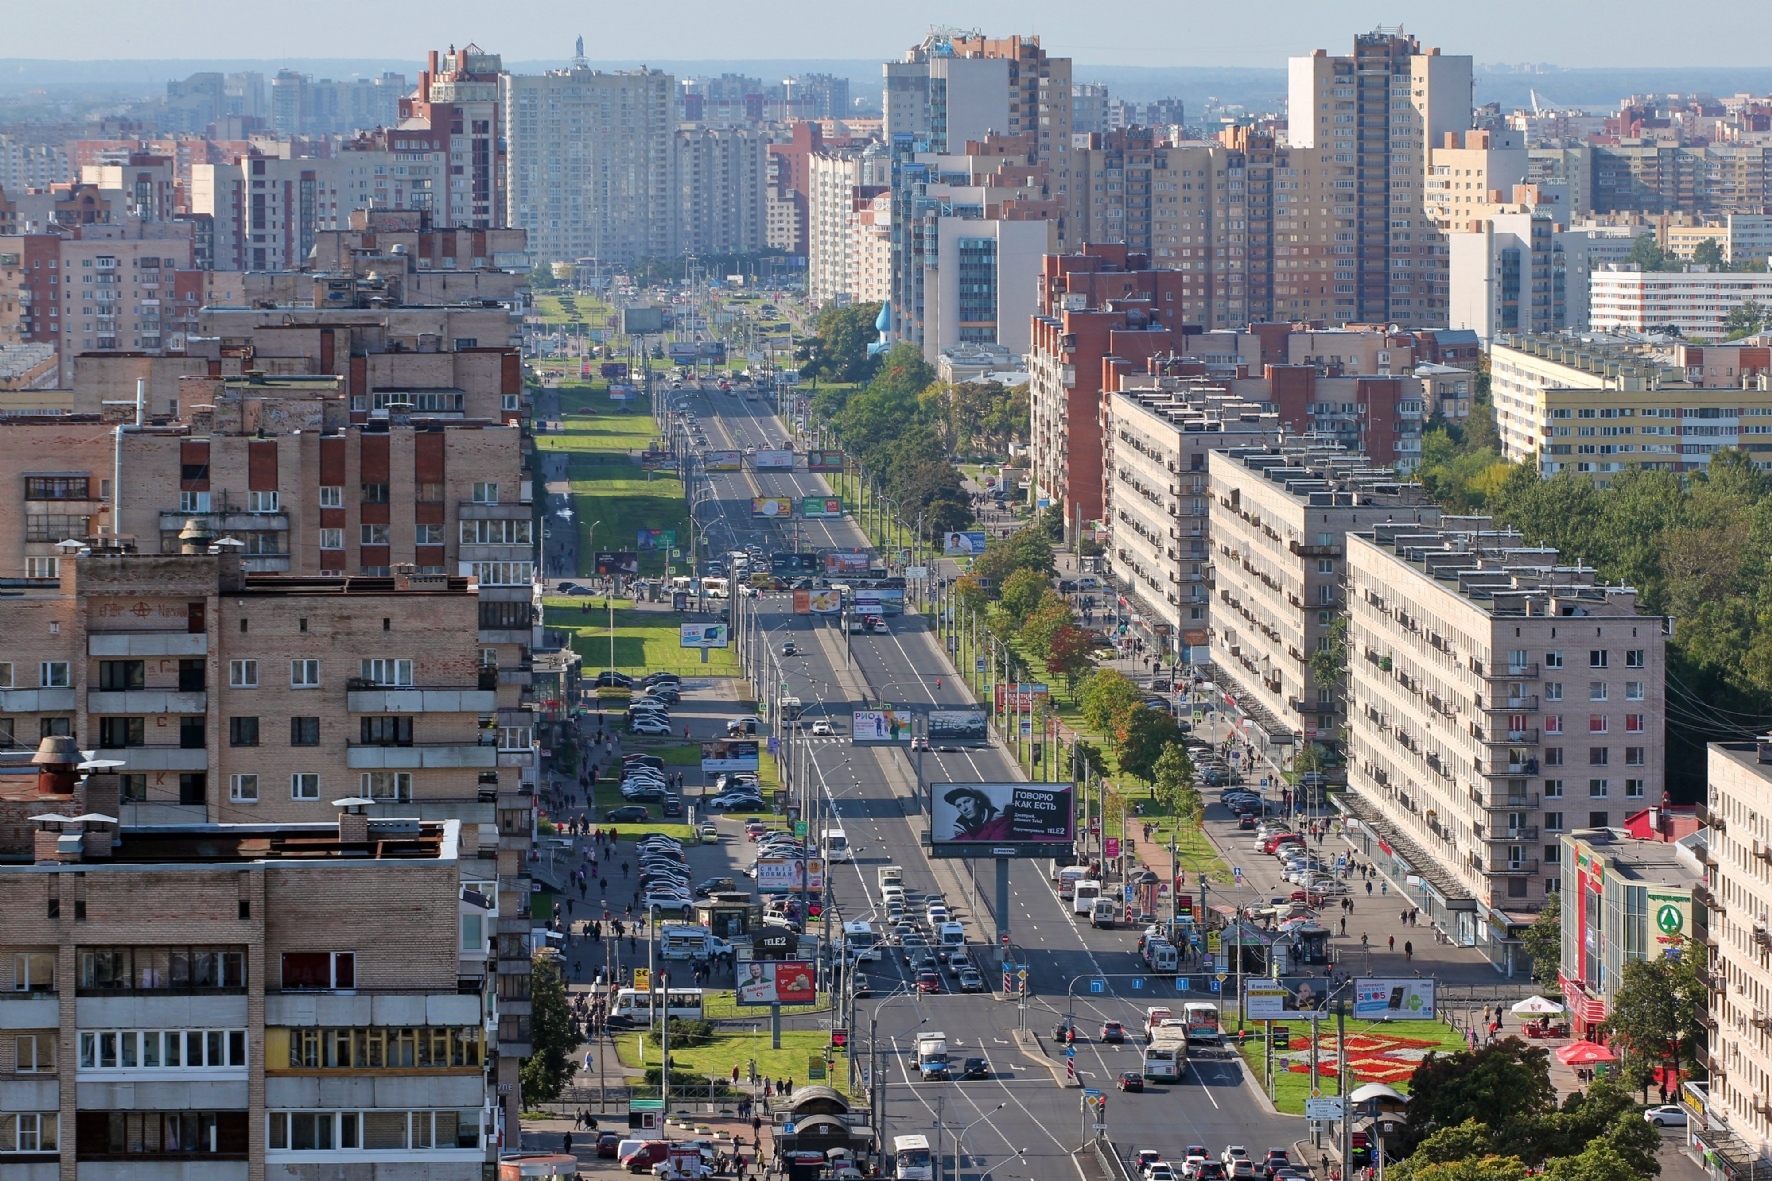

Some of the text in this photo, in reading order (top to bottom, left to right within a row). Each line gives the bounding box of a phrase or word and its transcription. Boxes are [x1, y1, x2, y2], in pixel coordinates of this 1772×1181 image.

[855, 712, 875, 720] РИО
[1015, 790, 1054, 801] ГОВОРЮ
[1014, 800, 1057, 811] КАК ЕСТЬ
[1047, 827, 1065, 835] TELE2
[763, 936, 787, 946] TELE2
